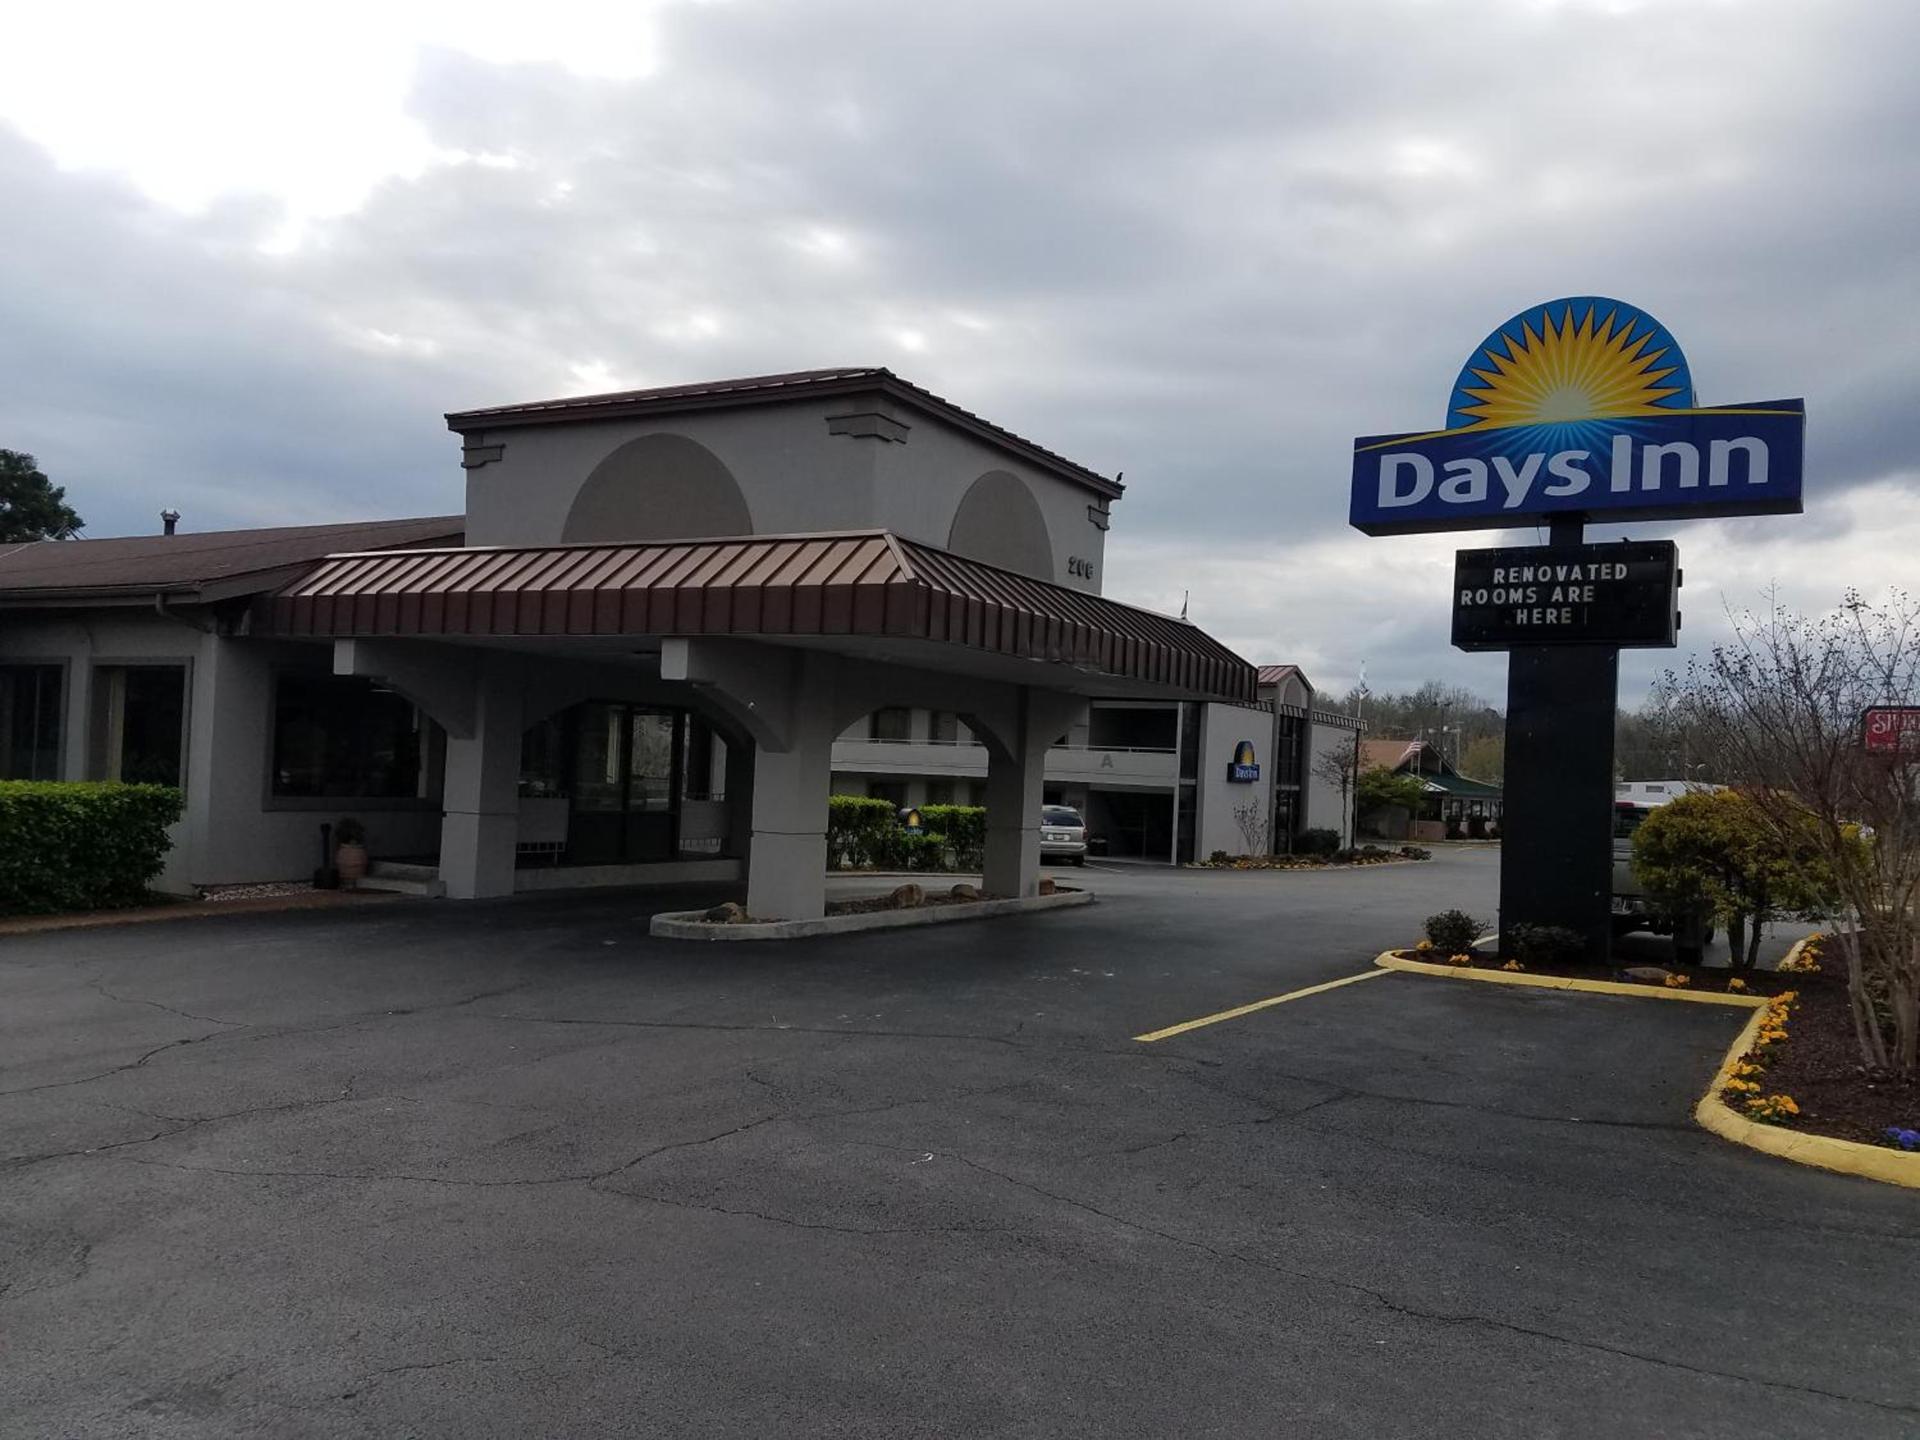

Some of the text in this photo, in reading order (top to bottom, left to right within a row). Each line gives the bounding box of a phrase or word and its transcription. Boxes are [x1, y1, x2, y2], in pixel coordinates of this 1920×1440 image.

[1377, 434, 1769, 508] Days Inn
[1493, 563, 1628, 584] RENOVATED
[1461, 586, 1595, 605] ROOMS ARE
[1516, 608, 1572, 625] HERE
[1102, 754, 1114, 768] A
